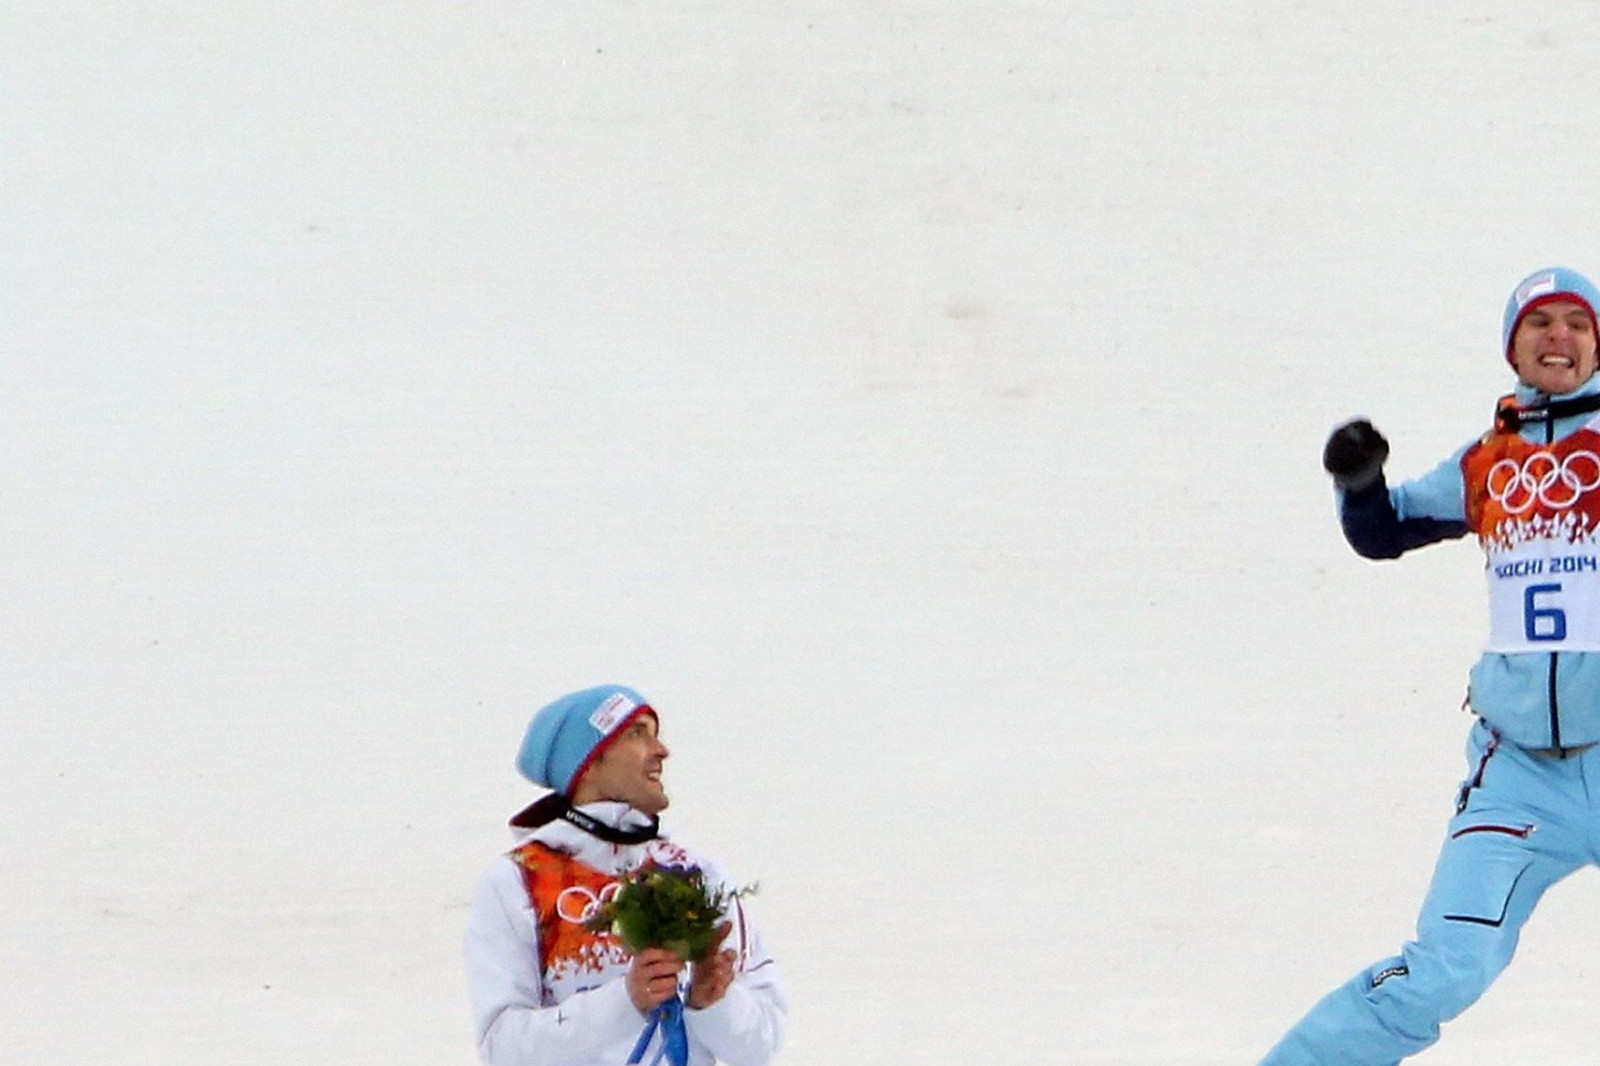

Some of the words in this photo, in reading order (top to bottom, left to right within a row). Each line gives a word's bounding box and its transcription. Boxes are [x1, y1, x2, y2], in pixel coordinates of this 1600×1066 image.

[1495, 559, 1542, 579] SOCHI
[1550, 555, 1597, 573] 2014
[1524, 583, 1566, 642] 6
